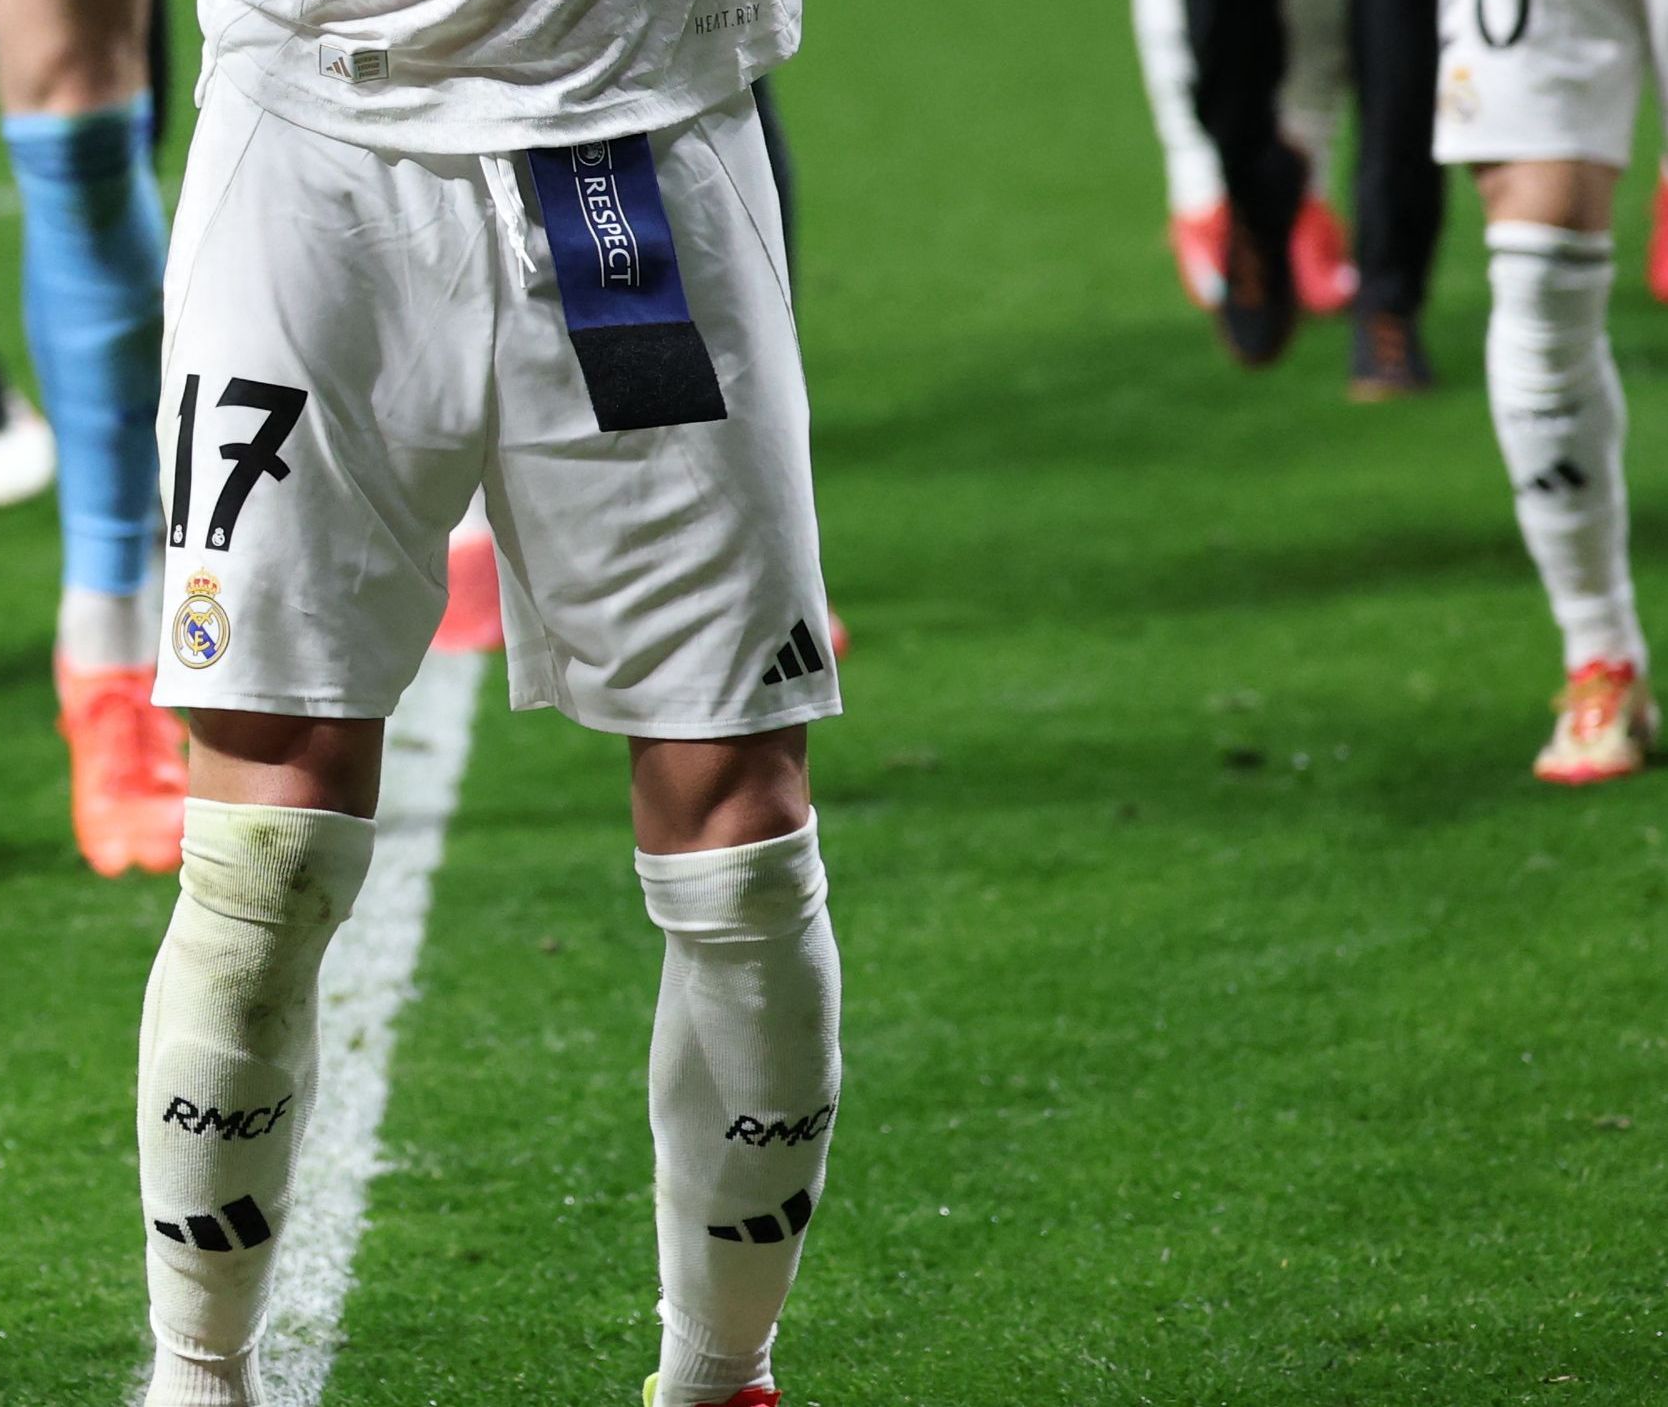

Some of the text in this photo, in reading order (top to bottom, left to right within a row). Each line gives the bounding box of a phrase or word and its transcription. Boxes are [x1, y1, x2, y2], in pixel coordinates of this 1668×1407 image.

[694, 3, 761, 35] HEAT.RDY
[584, 176, 632, 286] RESPECT
[169, 374, 308, 552] 17
[163, 1093, 292, 1141] RMCF
